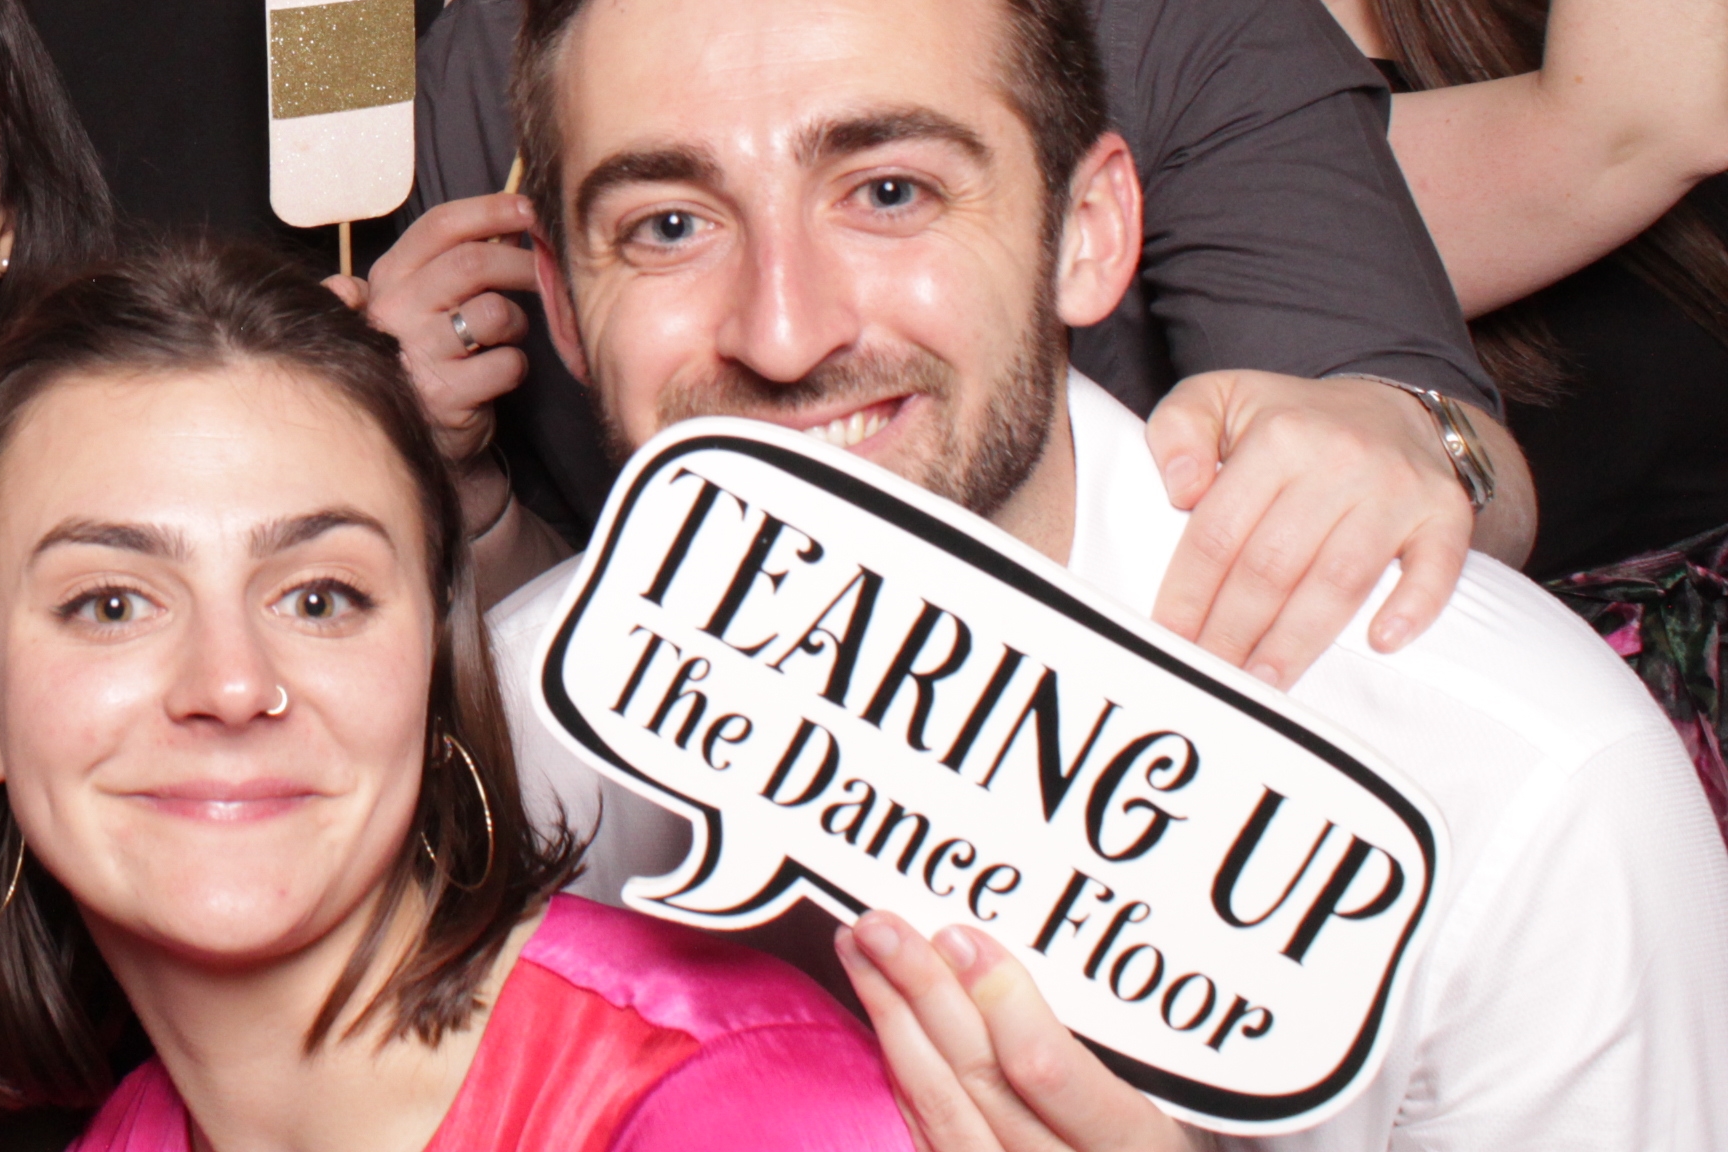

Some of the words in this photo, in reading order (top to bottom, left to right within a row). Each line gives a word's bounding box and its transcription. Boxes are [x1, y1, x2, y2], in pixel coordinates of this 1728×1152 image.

[610, 624, 754, 771] The
[758, 716, 1022, 921] Dance
[1028, 866, 1274, 1053] Floor
[638, 467, 1200, 864] TEARING
[1210, 783, 1406, 966] UP
